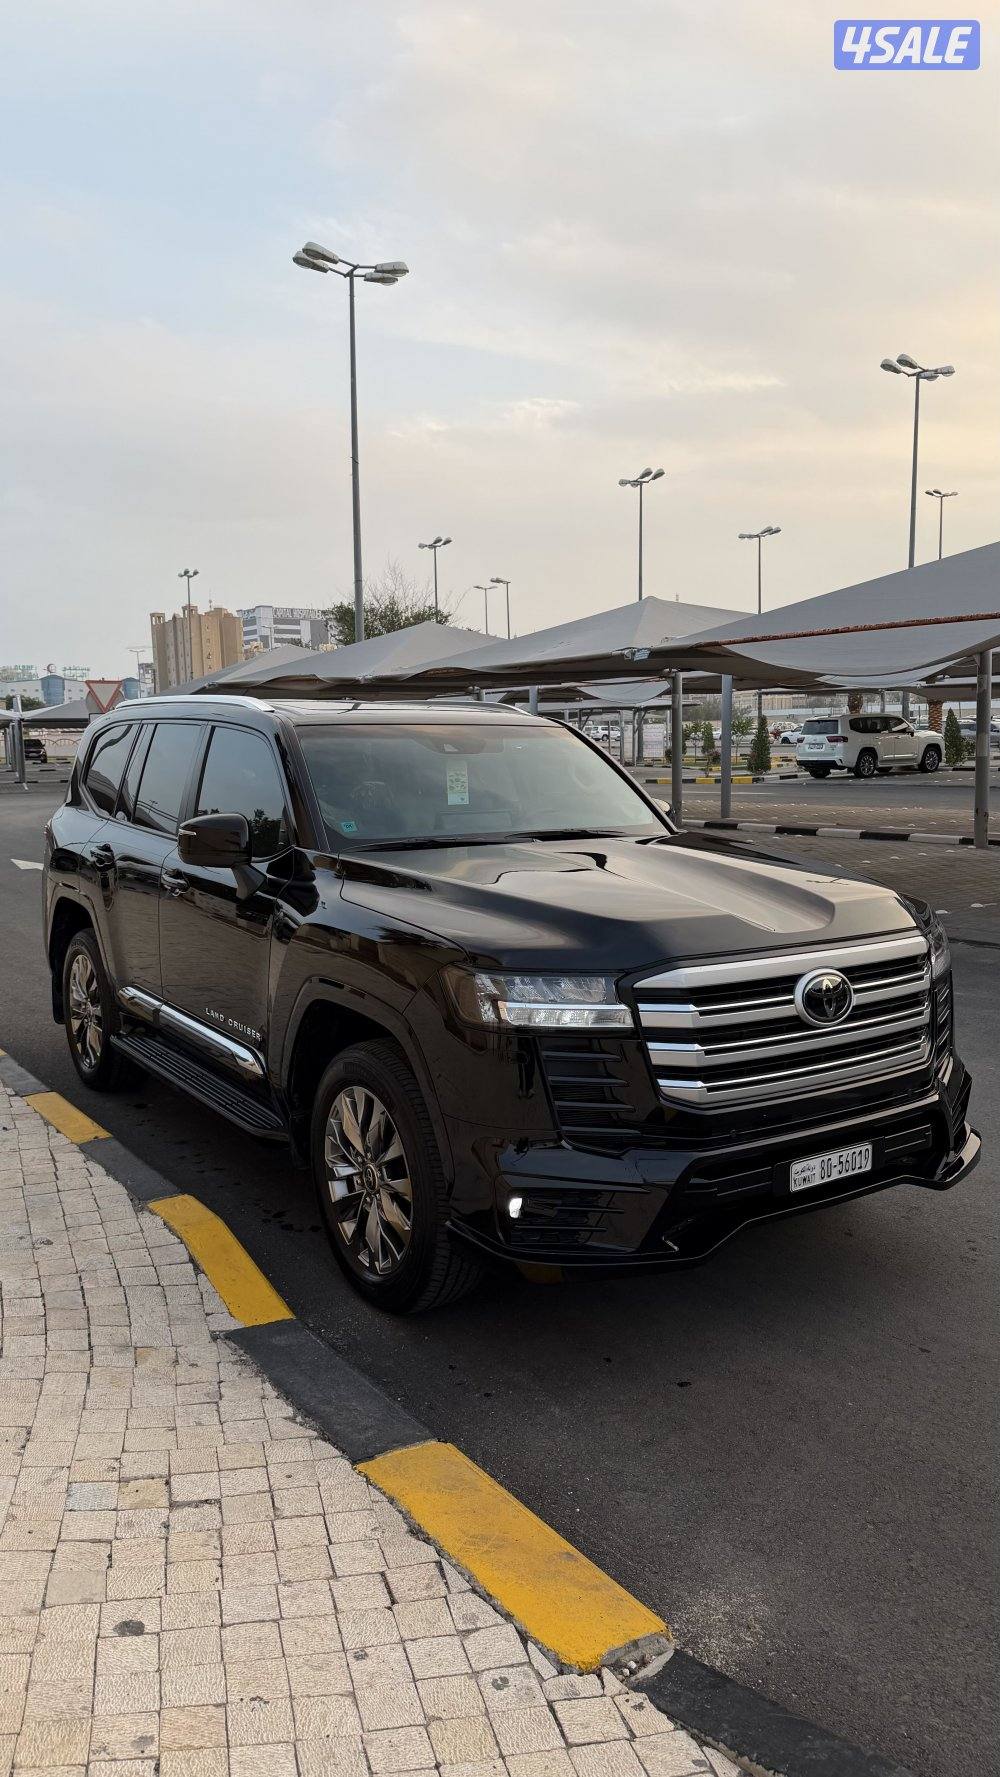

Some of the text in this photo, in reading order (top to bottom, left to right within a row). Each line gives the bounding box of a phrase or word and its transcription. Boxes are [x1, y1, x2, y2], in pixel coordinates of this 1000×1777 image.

[205, 1007, 262, 1042] LAND CRUISER
[820, 1147, 870, 1180] 80-56019
[793, 1173, 816, 1188] KUWAIT
